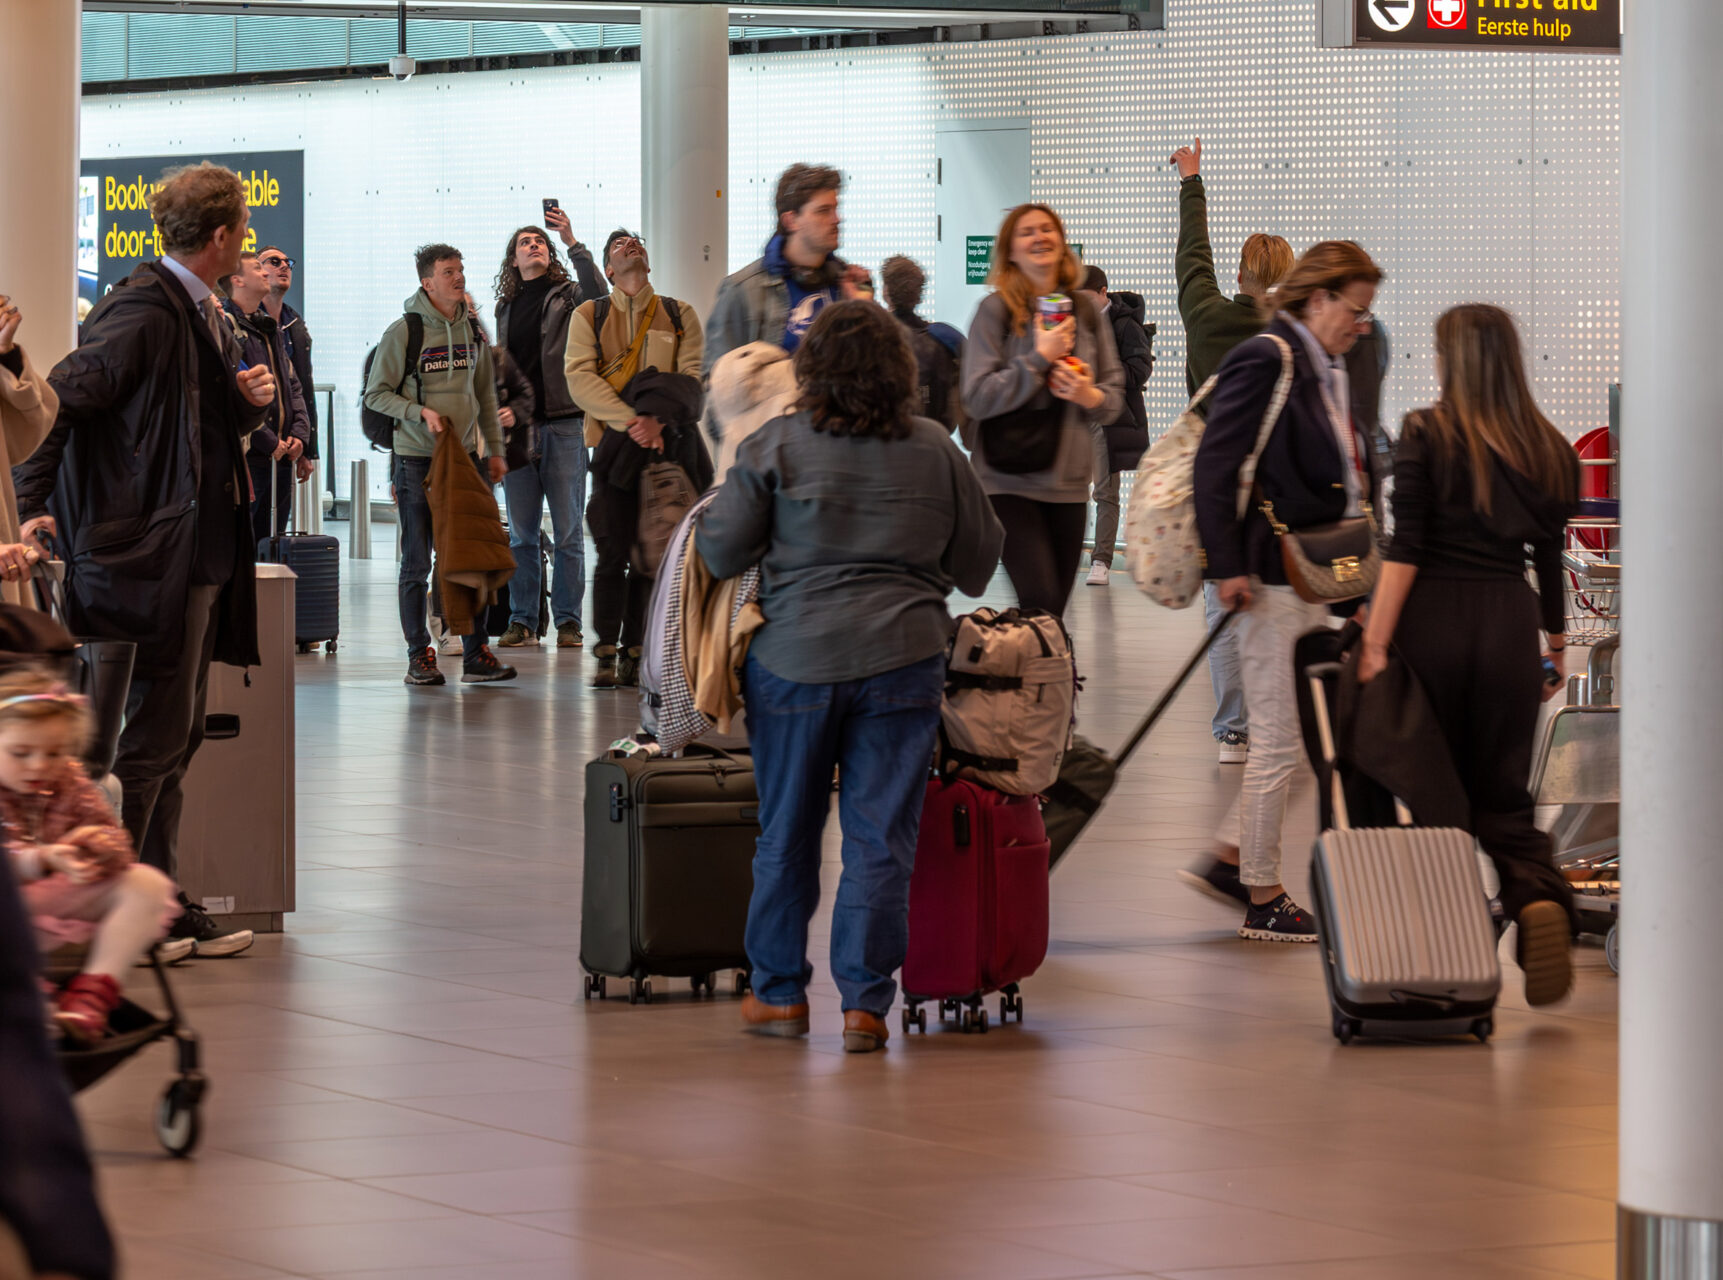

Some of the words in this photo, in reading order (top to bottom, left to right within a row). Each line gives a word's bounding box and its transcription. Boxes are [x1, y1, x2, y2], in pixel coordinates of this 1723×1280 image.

[1477, 17, 1529, 36] Eerste
[1533, 18, 1572, 41] hulp
[104, 175, 148, 212] Book
[237, 170, 280, 207] able
